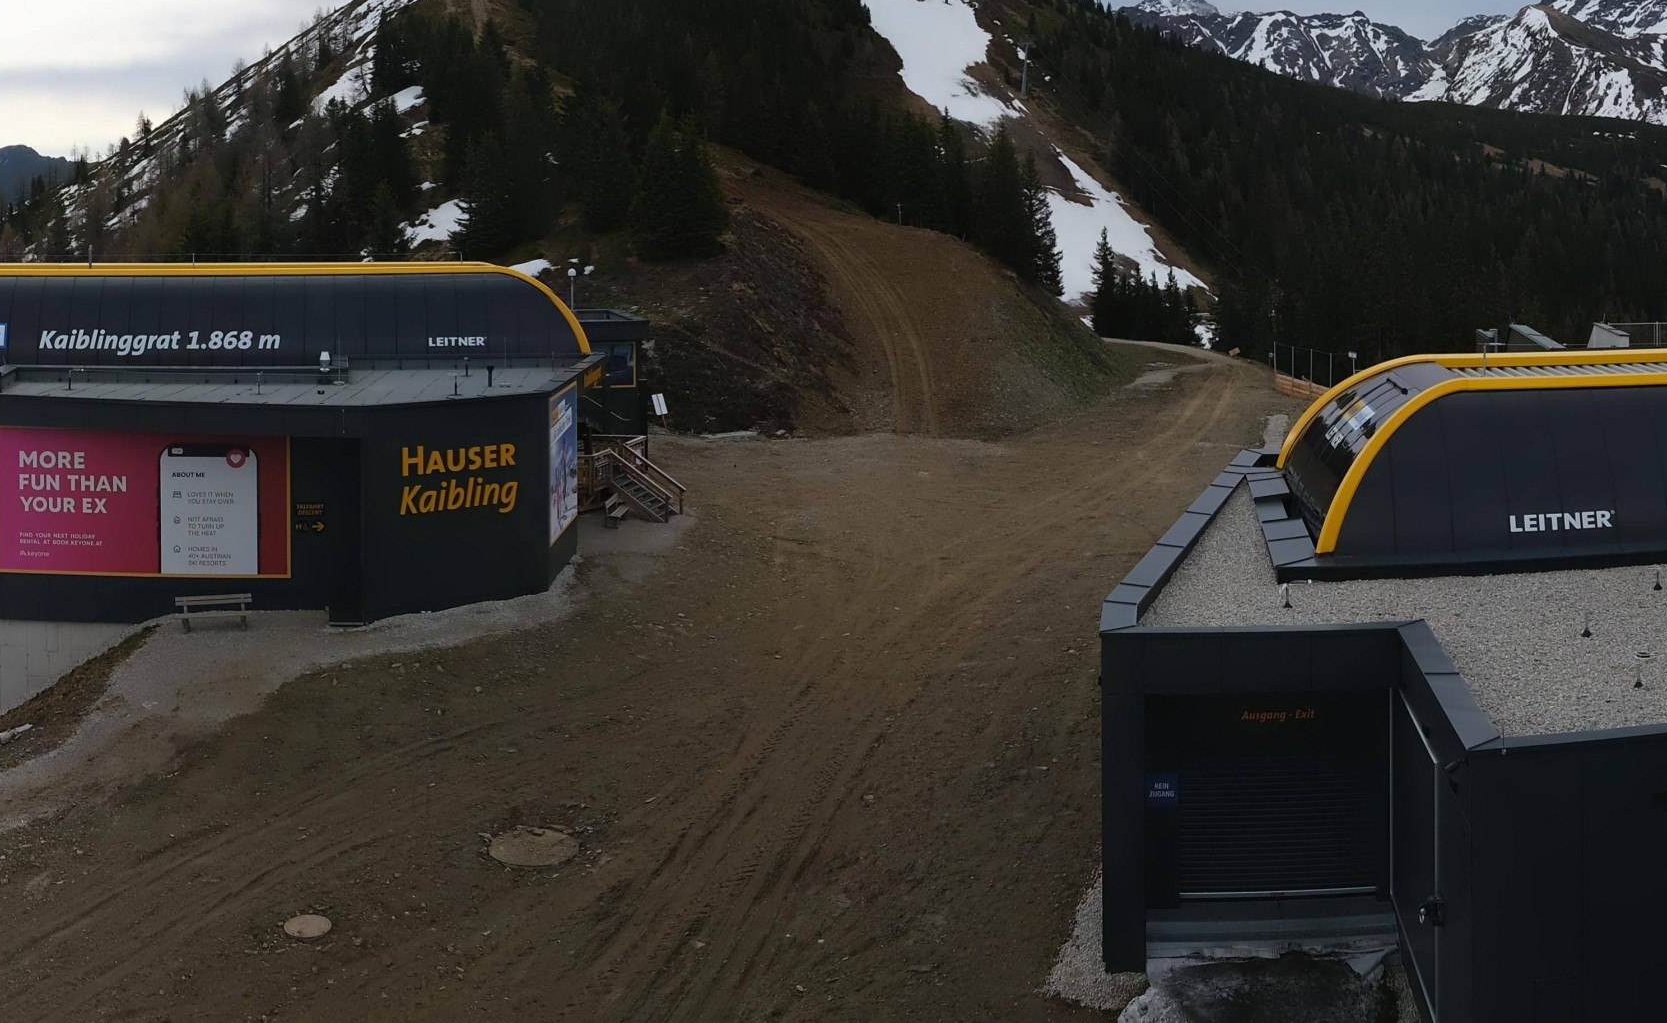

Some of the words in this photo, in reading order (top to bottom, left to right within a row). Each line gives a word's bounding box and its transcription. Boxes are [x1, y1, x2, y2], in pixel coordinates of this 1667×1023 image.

[39, 329, 180, 355] Kaiblinggrat
[186, 330, 253, 349] 1.868
[258, 334, 281, 349] m
[428, 336, 485, 347] LEITNER
[19, 450, 86, 469] MORE
[401, 443, 516, 476] HAUSER
[19, 474, 60, 490] FUN
[68, 475, 127, 492] THAN
[20, 496, 76, 513] YOUR
[82, 498, 107, 514] EX
[400, 477, 519, 515] Kaibling
[1509, 510, 1613, 533] LEITNER
[27, 550, 49, 558] keyone
[1241, 710, 1287, 723] Ausgang
[1295, 708, 1316, 719] Exit
[1149, 790, 1175, 798] ZUGANG
[1154, 782, 1169, 790] KEIN
